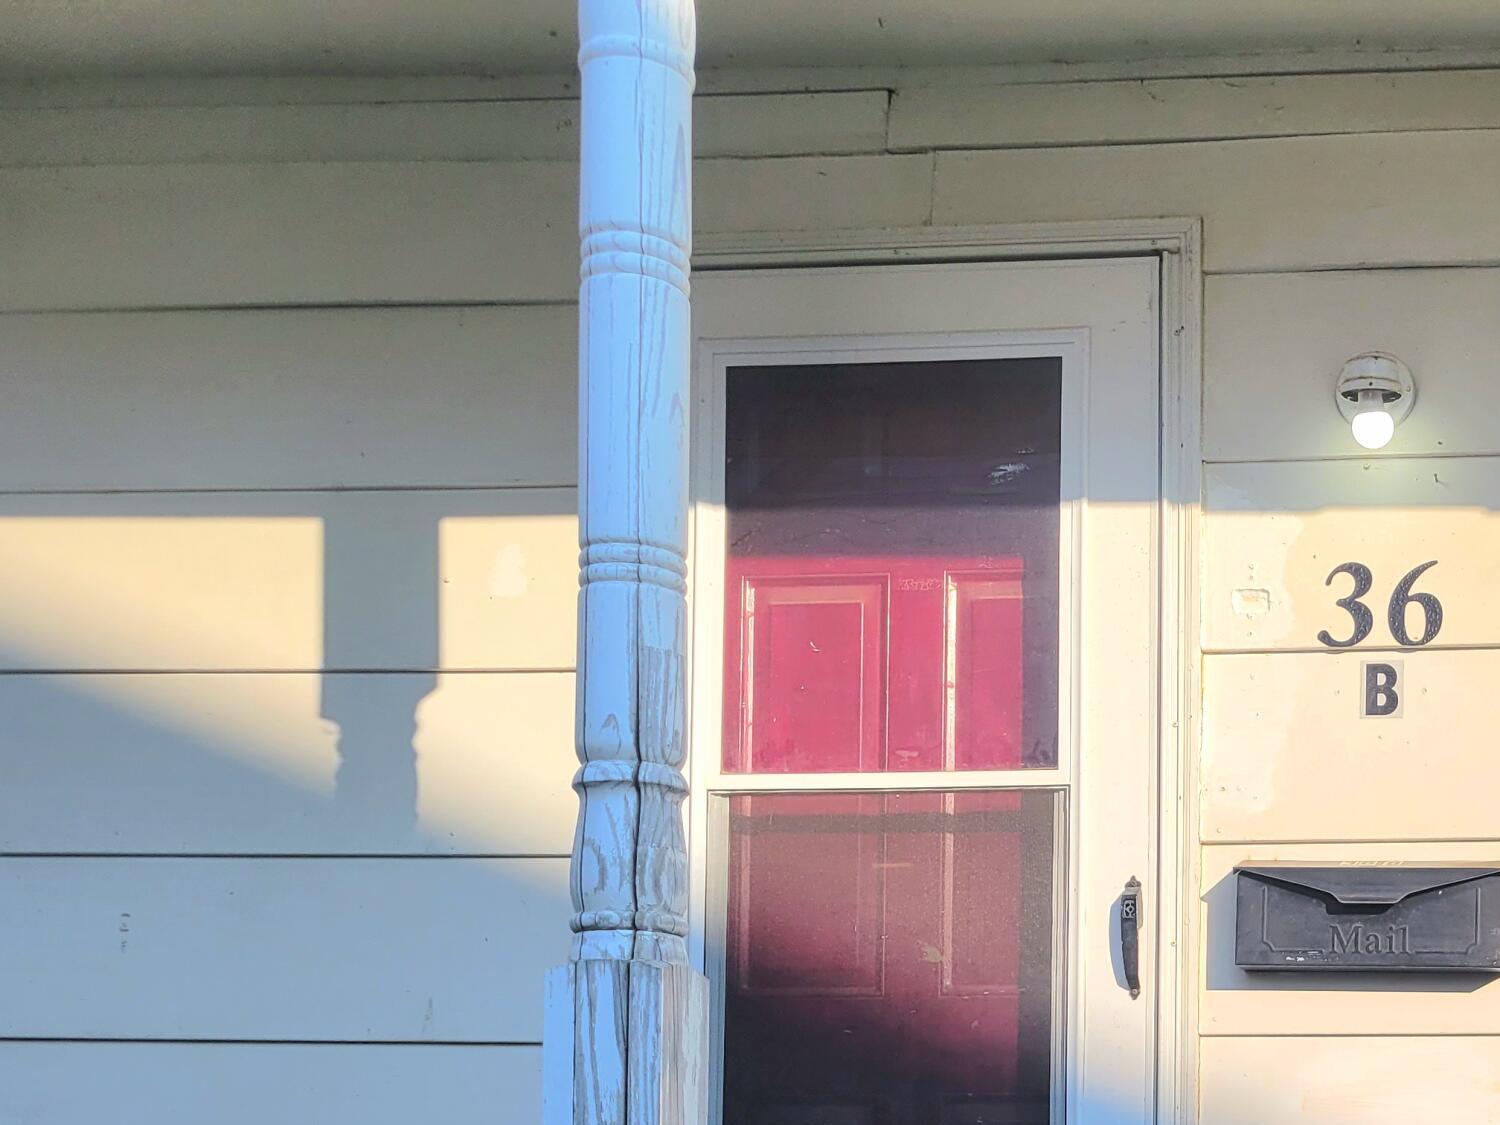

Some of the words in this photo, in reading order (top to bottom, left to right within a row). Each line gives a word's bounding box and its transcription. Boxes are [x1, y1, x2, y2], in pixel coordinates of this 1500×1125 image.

[1317, 560, 1444, 647] 36
[1365, 663, 1399, 716] B
[1328, 923, 1412, 955] Mail
